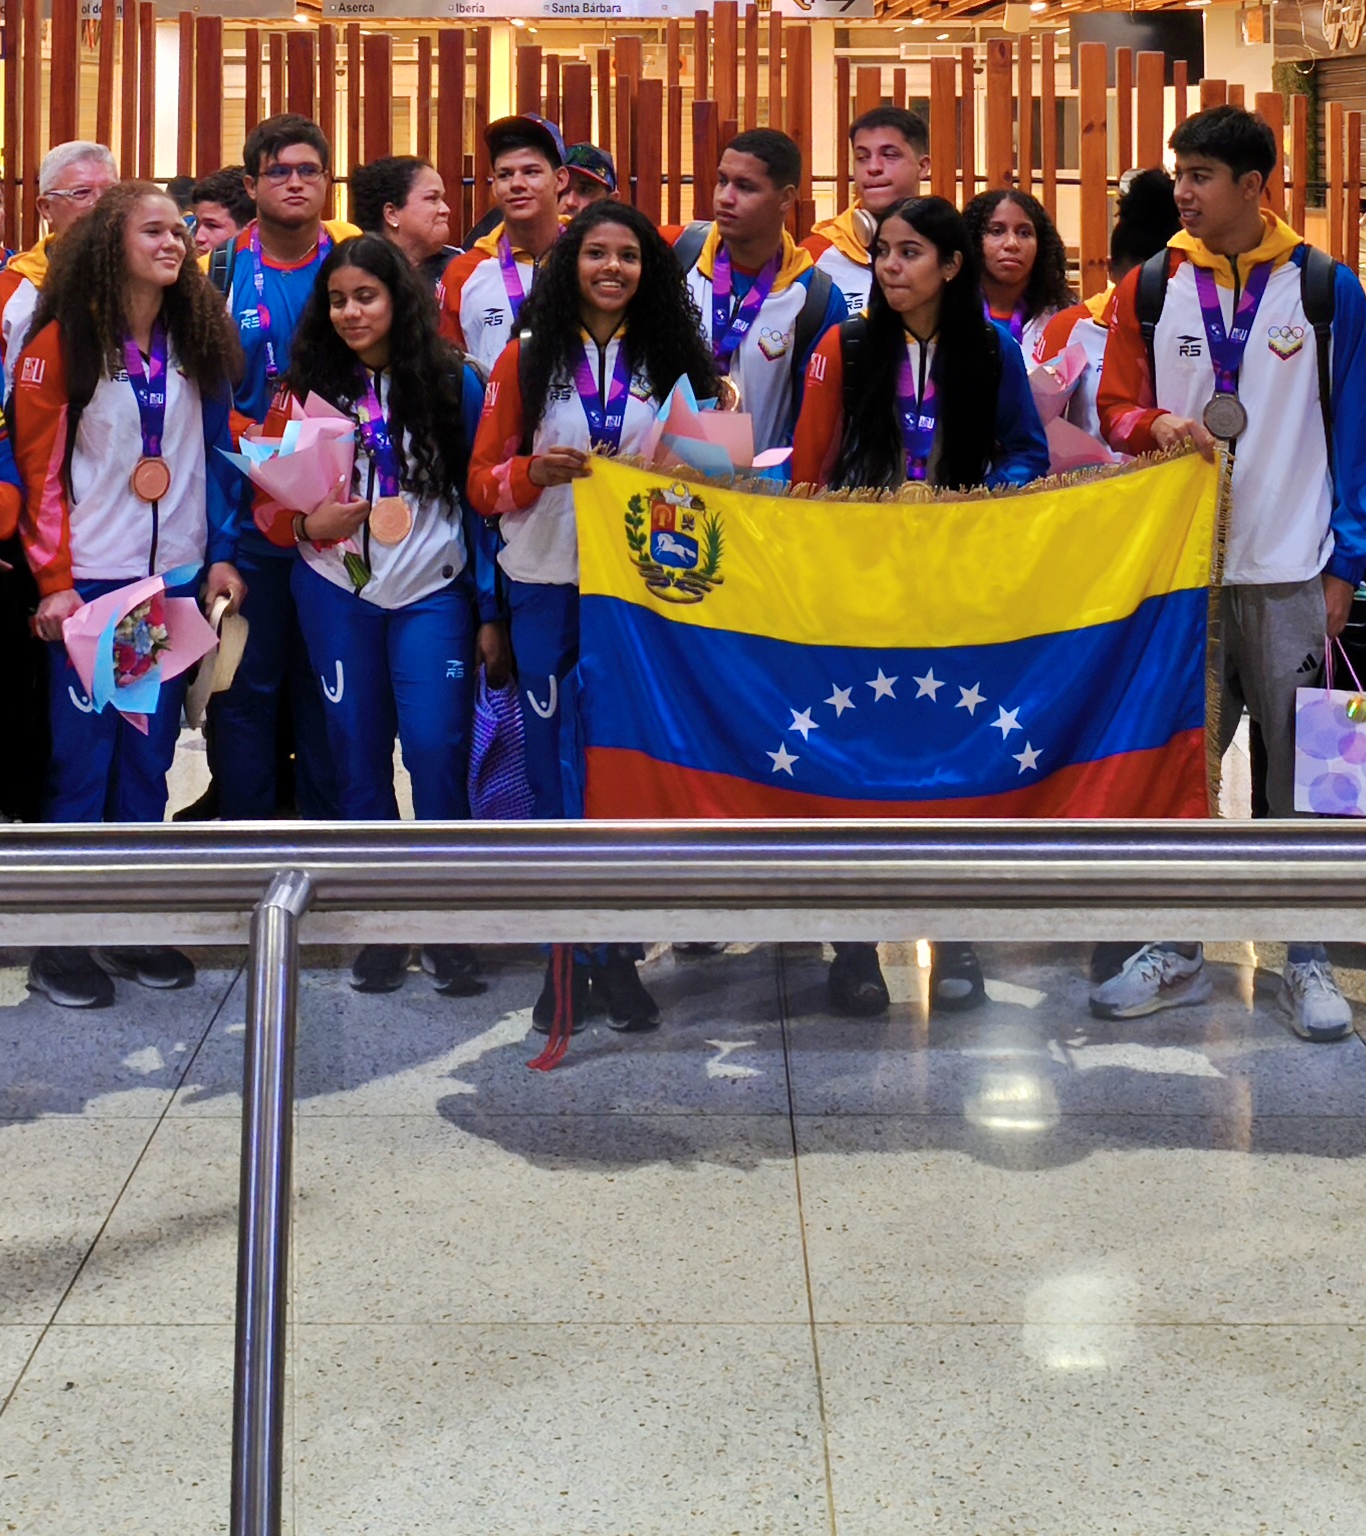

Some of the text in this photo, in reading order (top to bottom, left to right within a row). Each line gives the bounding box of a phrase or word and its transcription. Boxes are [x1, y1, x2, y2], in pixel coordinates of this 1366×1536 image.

[338, 2, 375, 13] Aserca
[551, 2, 622, 13] Santa Bárbara
